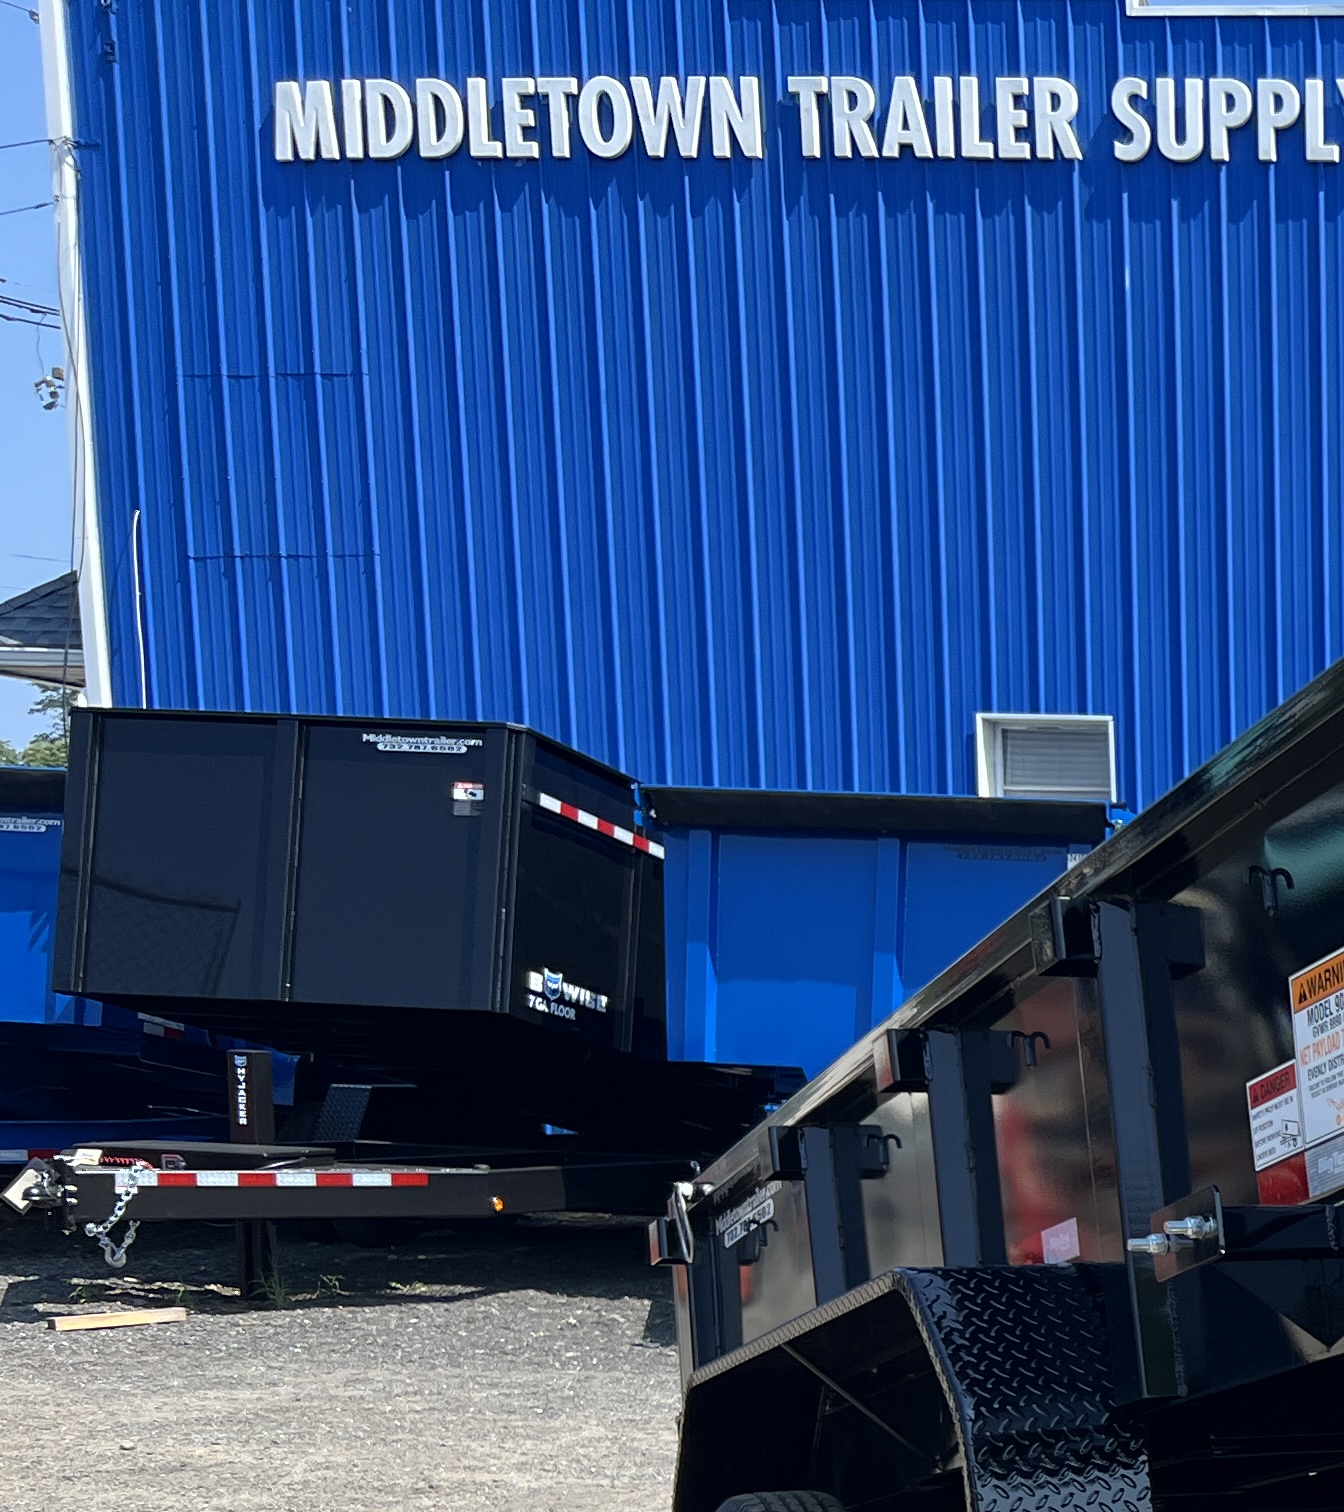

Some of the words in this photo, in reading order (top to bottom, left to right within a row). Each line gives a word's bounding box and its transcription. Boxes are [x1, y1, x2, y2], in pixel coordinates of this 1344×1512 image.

[275, 75, 763, 162] MIDDLETOWN
[788, 75, 1082, 161] TRAILER
[1307, 999, 1333, 1027] MODEL
[1312, 1031, 1340, 1060] PAYLOAD
